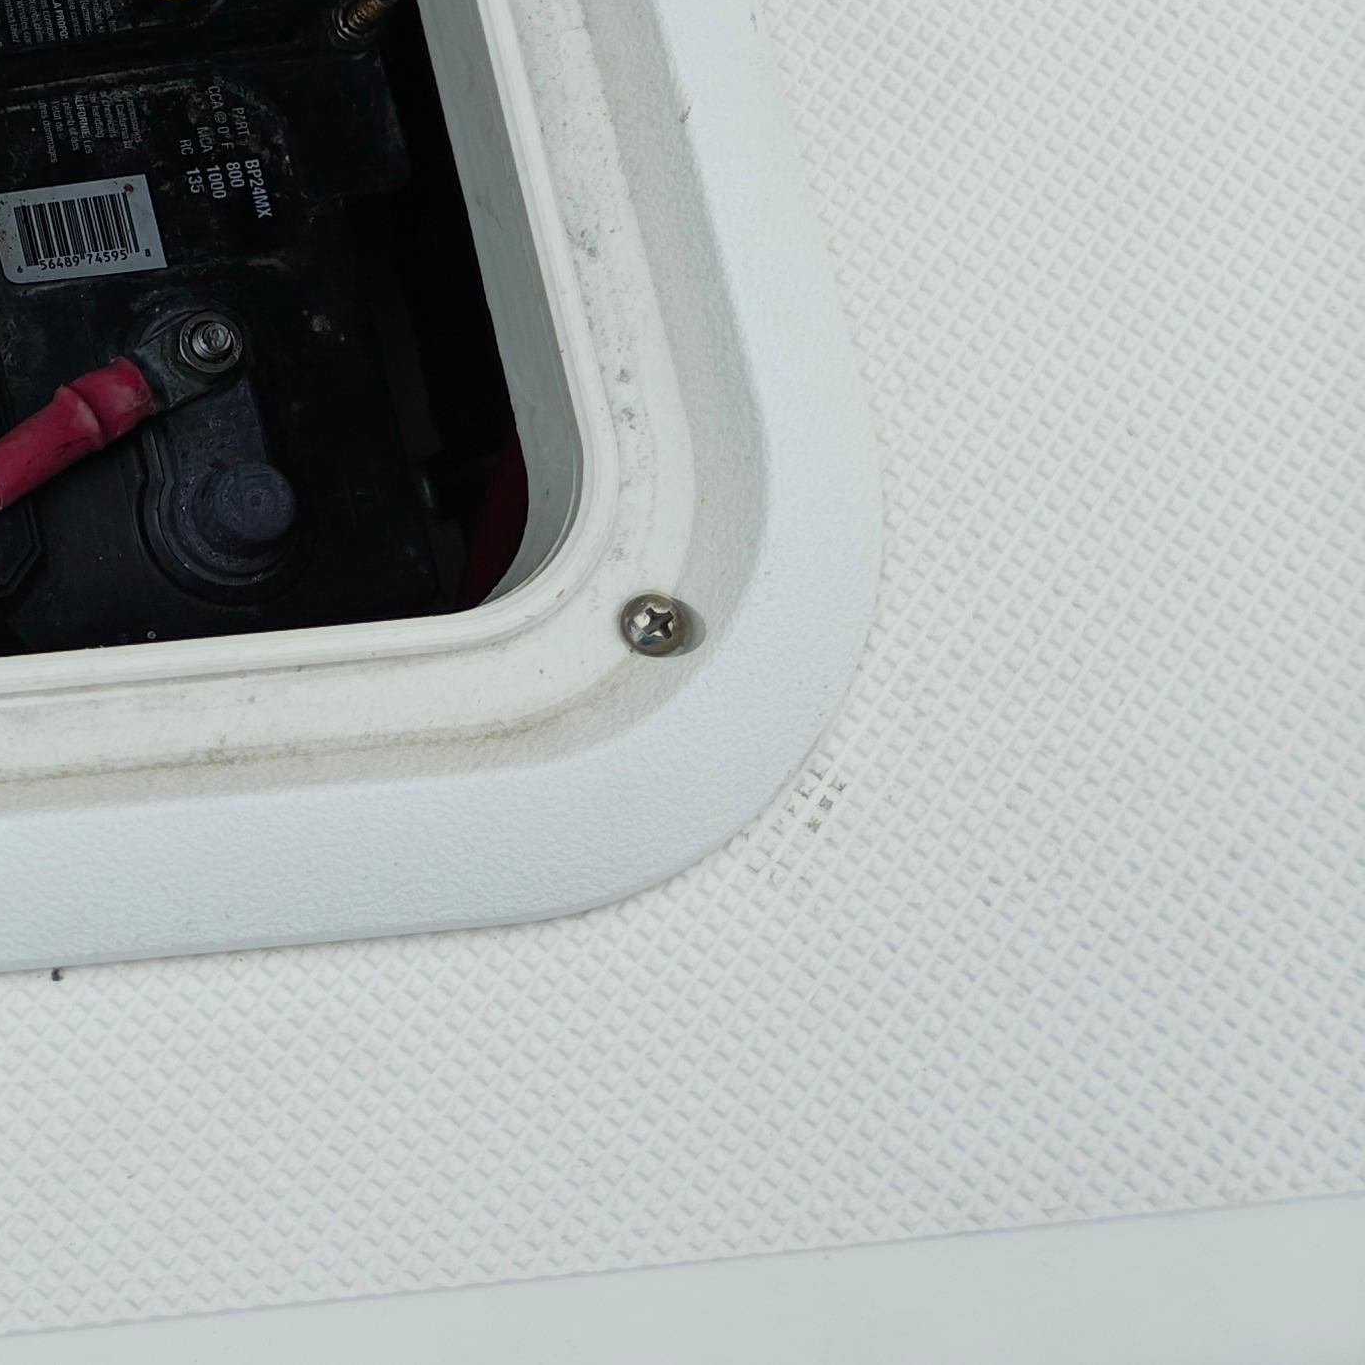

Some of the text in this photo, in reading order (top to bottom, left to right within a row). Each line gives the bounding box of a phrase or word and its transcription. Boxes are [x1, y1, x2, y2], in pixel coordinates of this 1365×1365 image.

[208, 85, 224, 109] CCA
[214, 111, 227, 123] @
[221, 142, 235, 150] F
[179, 138, 205, 194] RC 135
[196, 126, 227, 199] MCA 1000
[226, 162, 245, 187] 800
[244, 159, 273, 218] BP24MX
[39, 256, 79, 270] 56489
[88, 249, 127, 264] 74595
